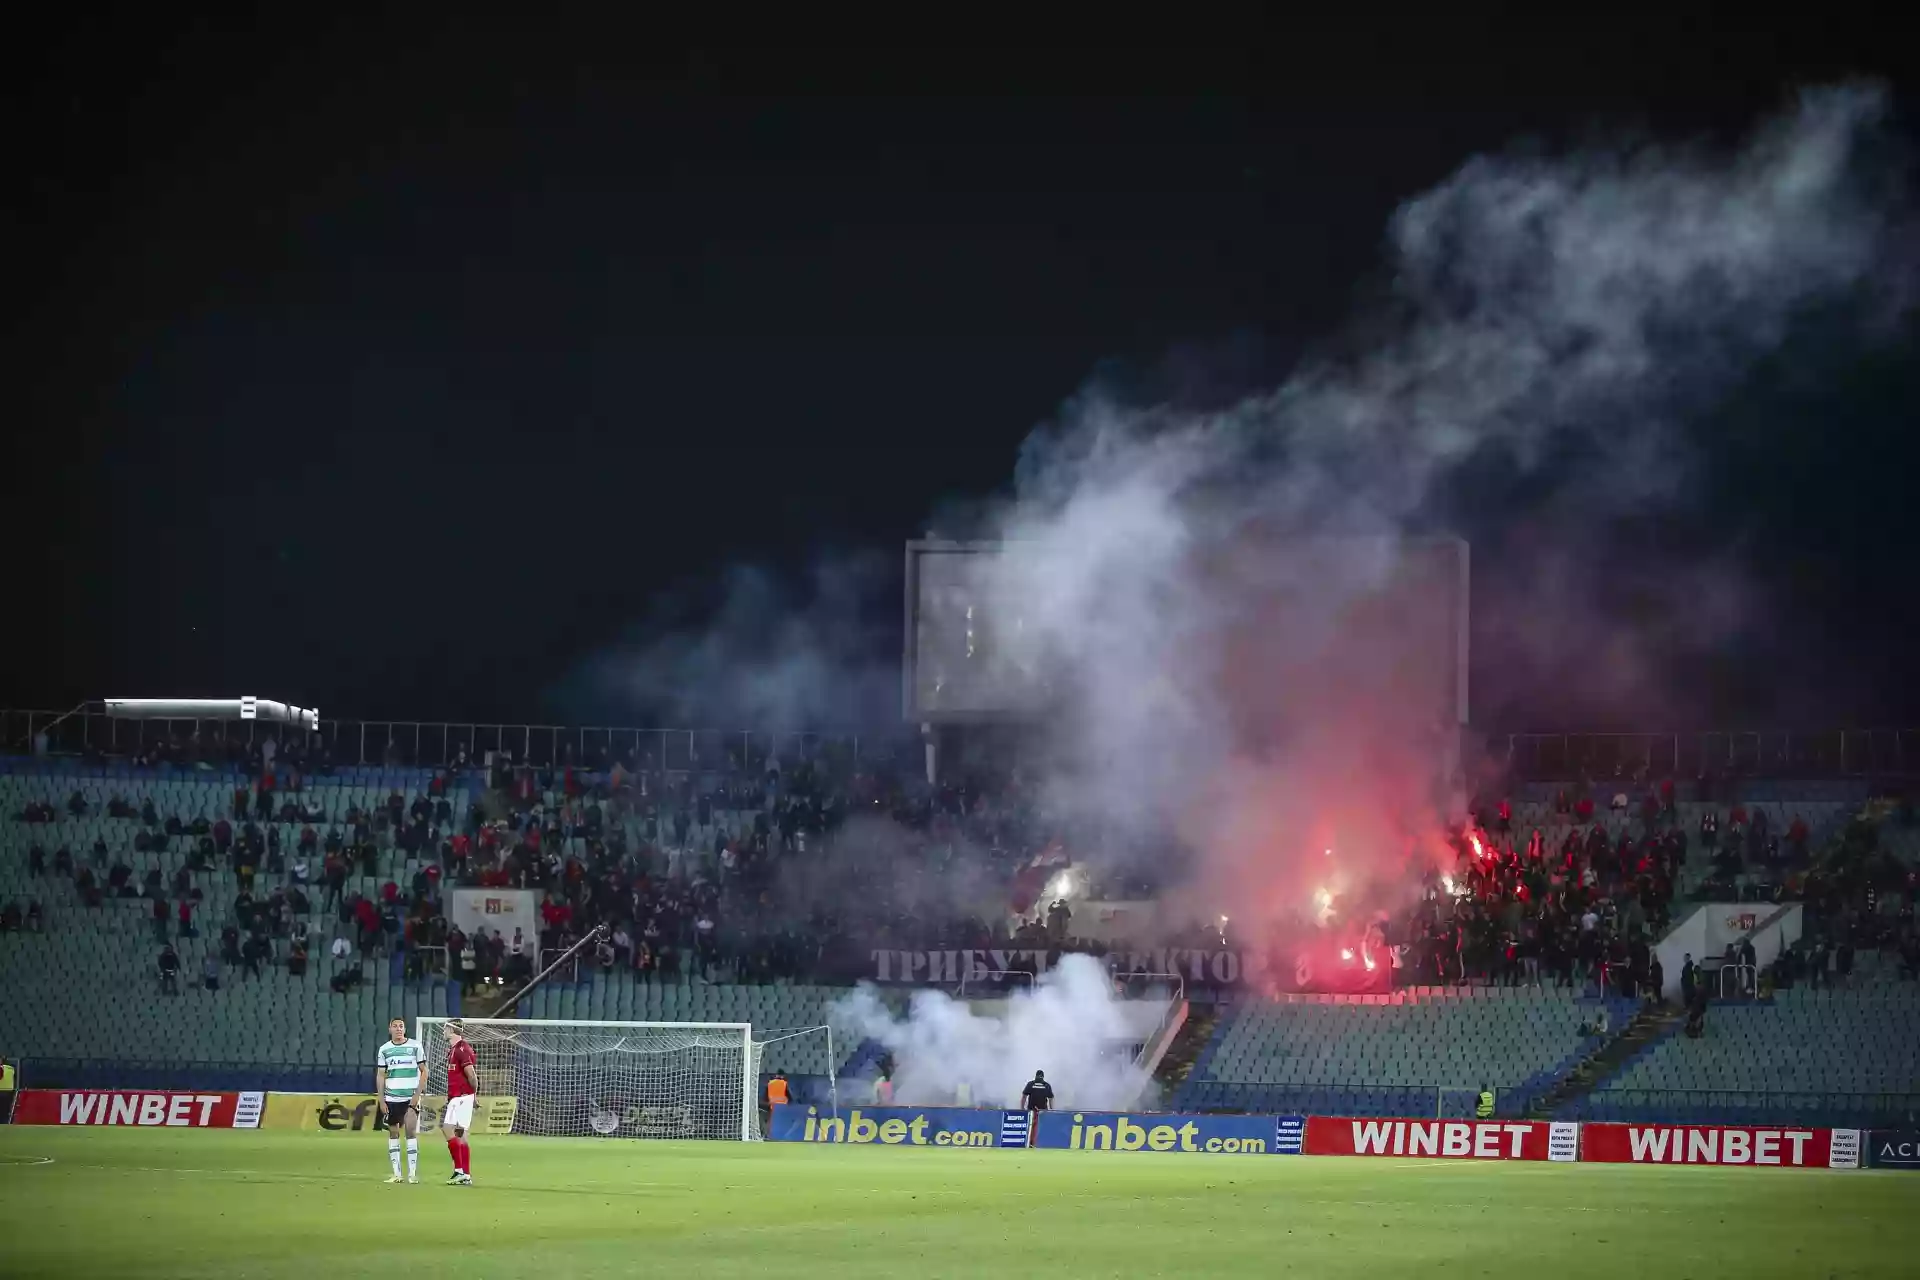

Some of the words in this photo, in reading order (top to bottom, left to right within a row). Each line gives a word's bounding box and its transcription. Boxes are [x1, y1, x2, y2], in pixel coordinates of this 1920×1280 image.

[60, 1094, 222, 1126] WINBET
[804, 1106, 993, 1146] inbet.com
[1069, 1113, 1266, 1153] inbet.com
[1352, 1121, 1532, 1158] WINBET
[1629, 1128, 1812, 1165] WINBET
